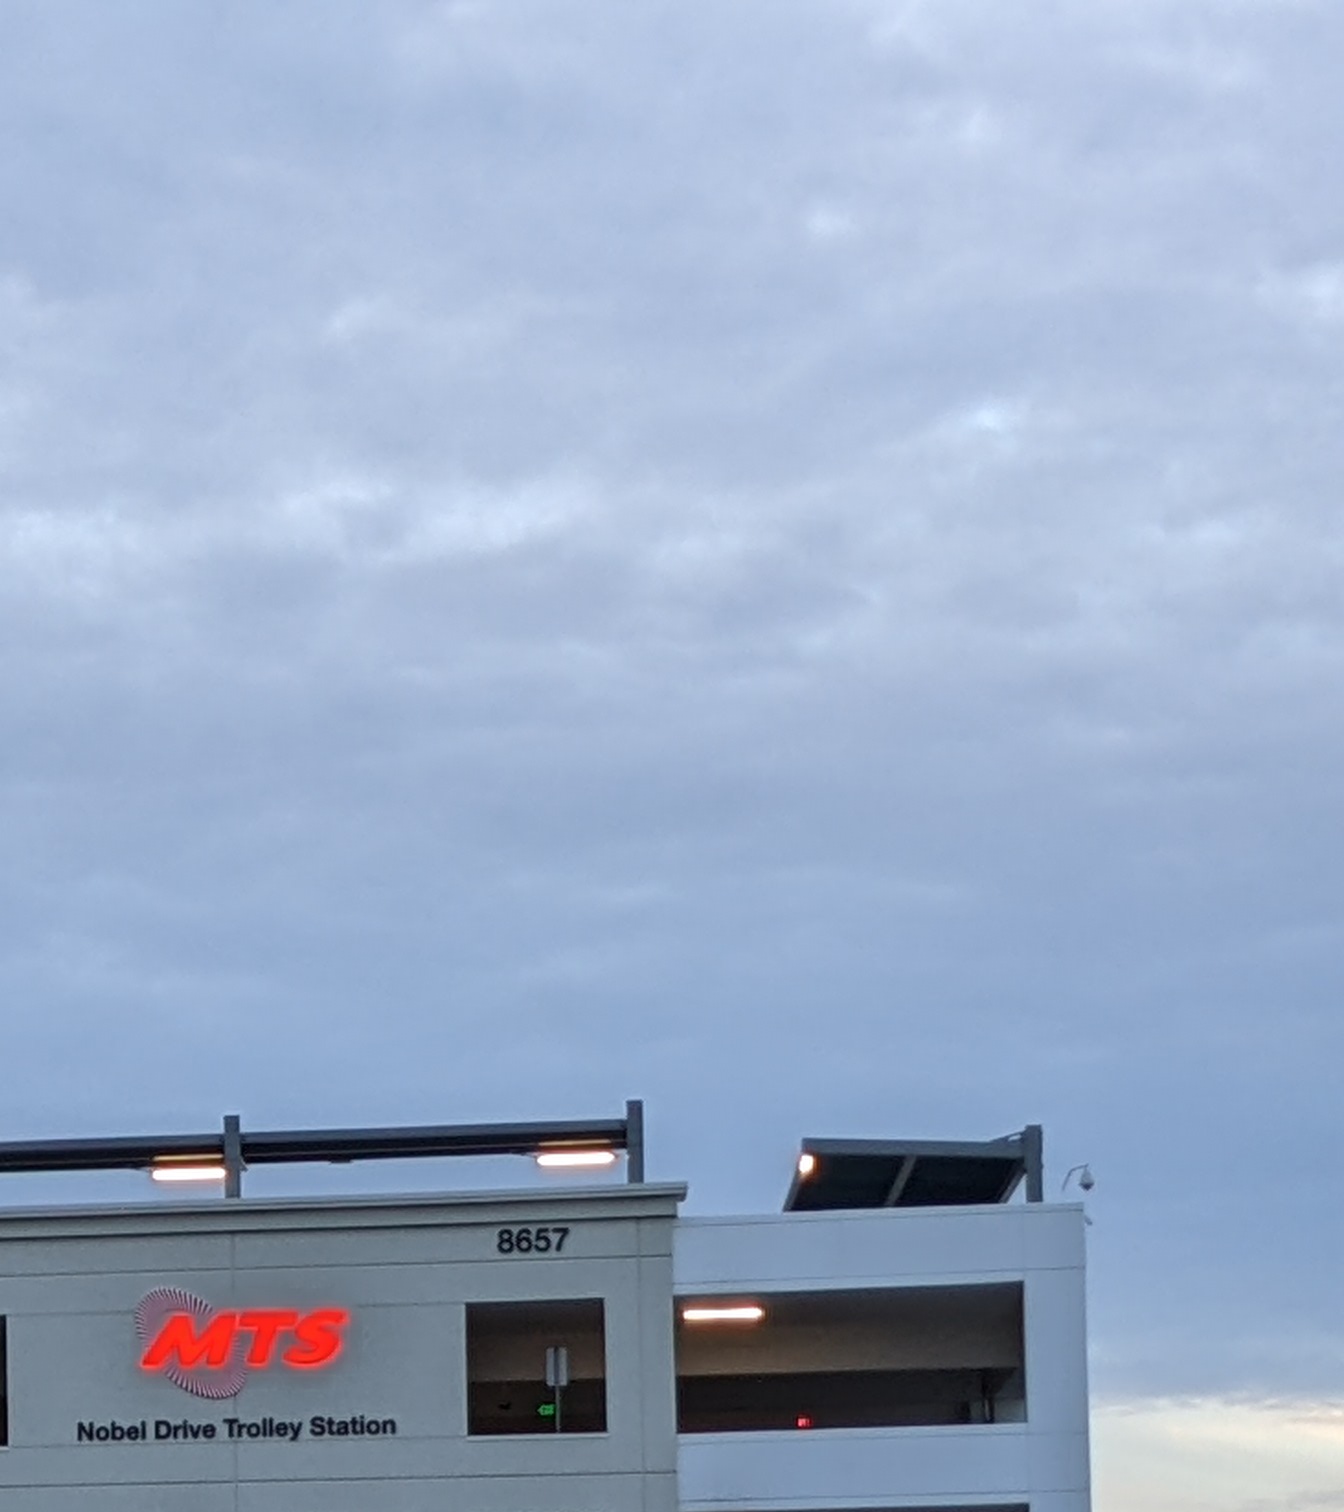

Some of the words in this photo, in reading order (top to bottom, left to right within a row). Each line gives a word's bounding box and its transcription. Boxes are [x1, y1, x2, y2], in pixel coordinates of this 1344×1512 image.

[496, 1226, 570, 1255] 8657
[139, 1309, 351, 1369] MTS
[77, 1421, 146, 1442] Nobel
[154, 1419, 216, 1439] Drive
[223, 1417, 302, 1441] Trolley
[309, 1415, 396, 1436] Station
